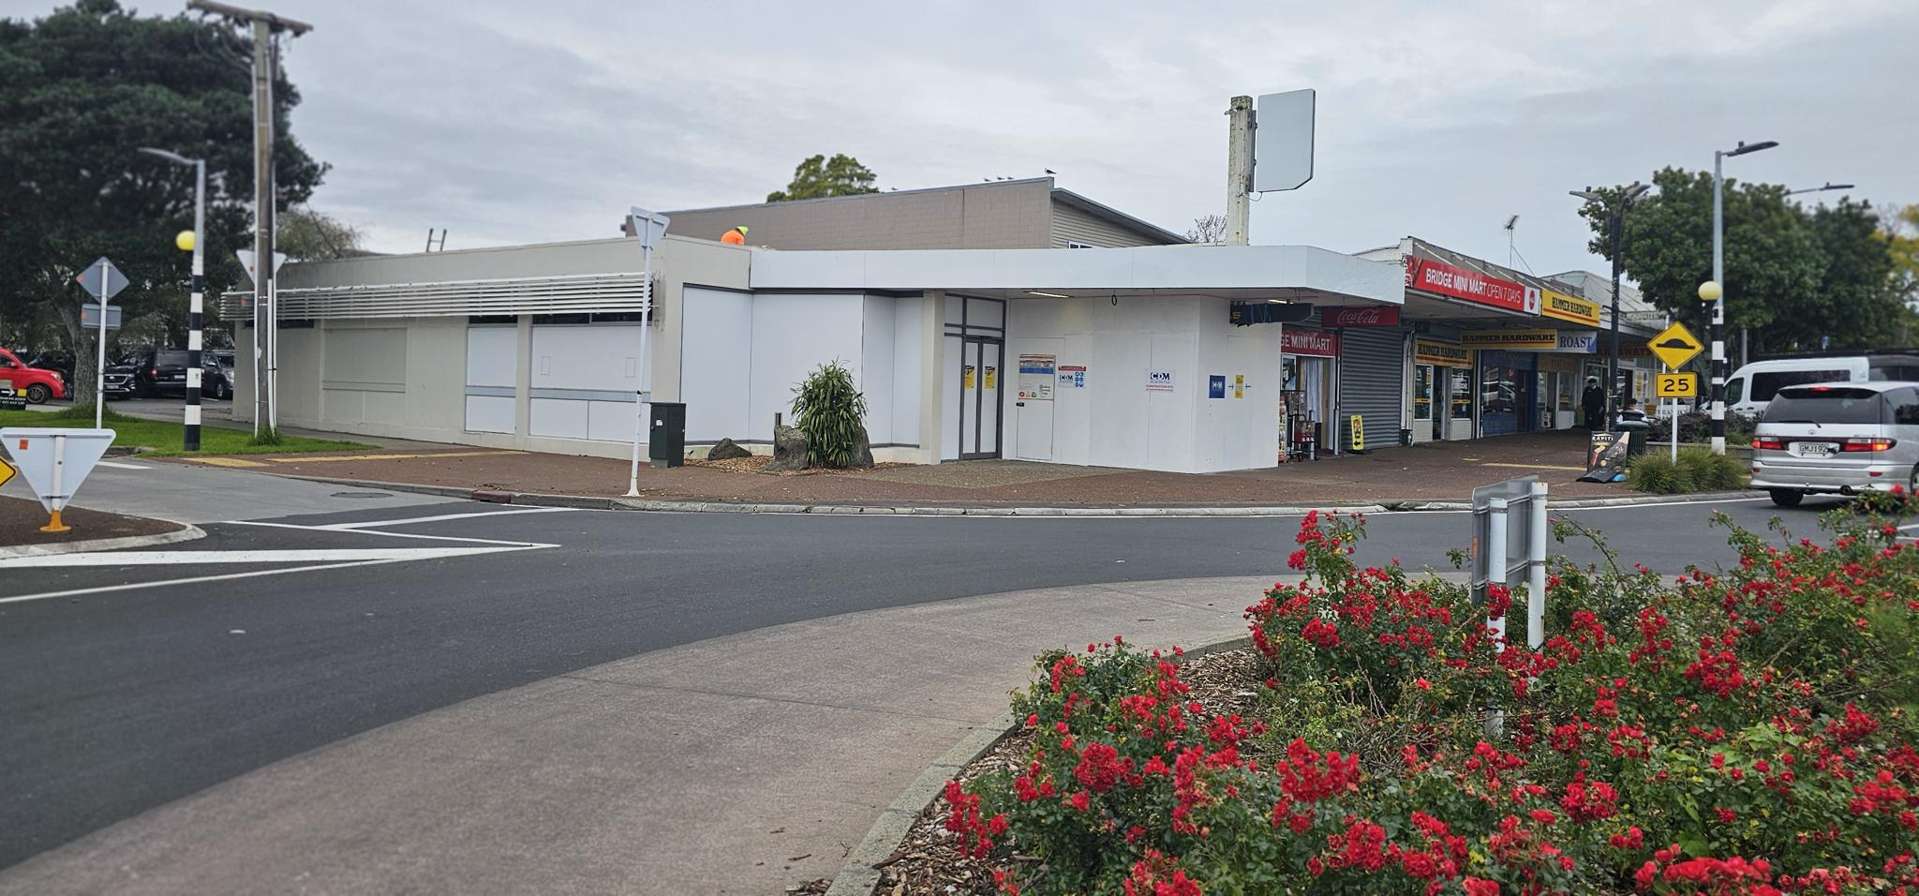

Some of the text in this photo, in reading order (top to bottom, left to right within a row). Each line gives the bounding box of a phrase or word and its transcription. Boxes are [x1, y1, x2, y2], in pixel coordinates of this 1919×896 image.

[1426, 268, 1452, 288] BRIDGE
[1453, 274, 1469, 291] MINI
[1469, 278, 1487, 295] MART
[1487, 282, 1502, 299] OPEN
[1508, 287, 1521, 304] DAYS
[1291, 335, 1309, 349] MINI
[1309, 336, 1330, 351] MART
[1559, 336, 1593, 348] ROAST
[1664, 378, 1689, 392] 25
